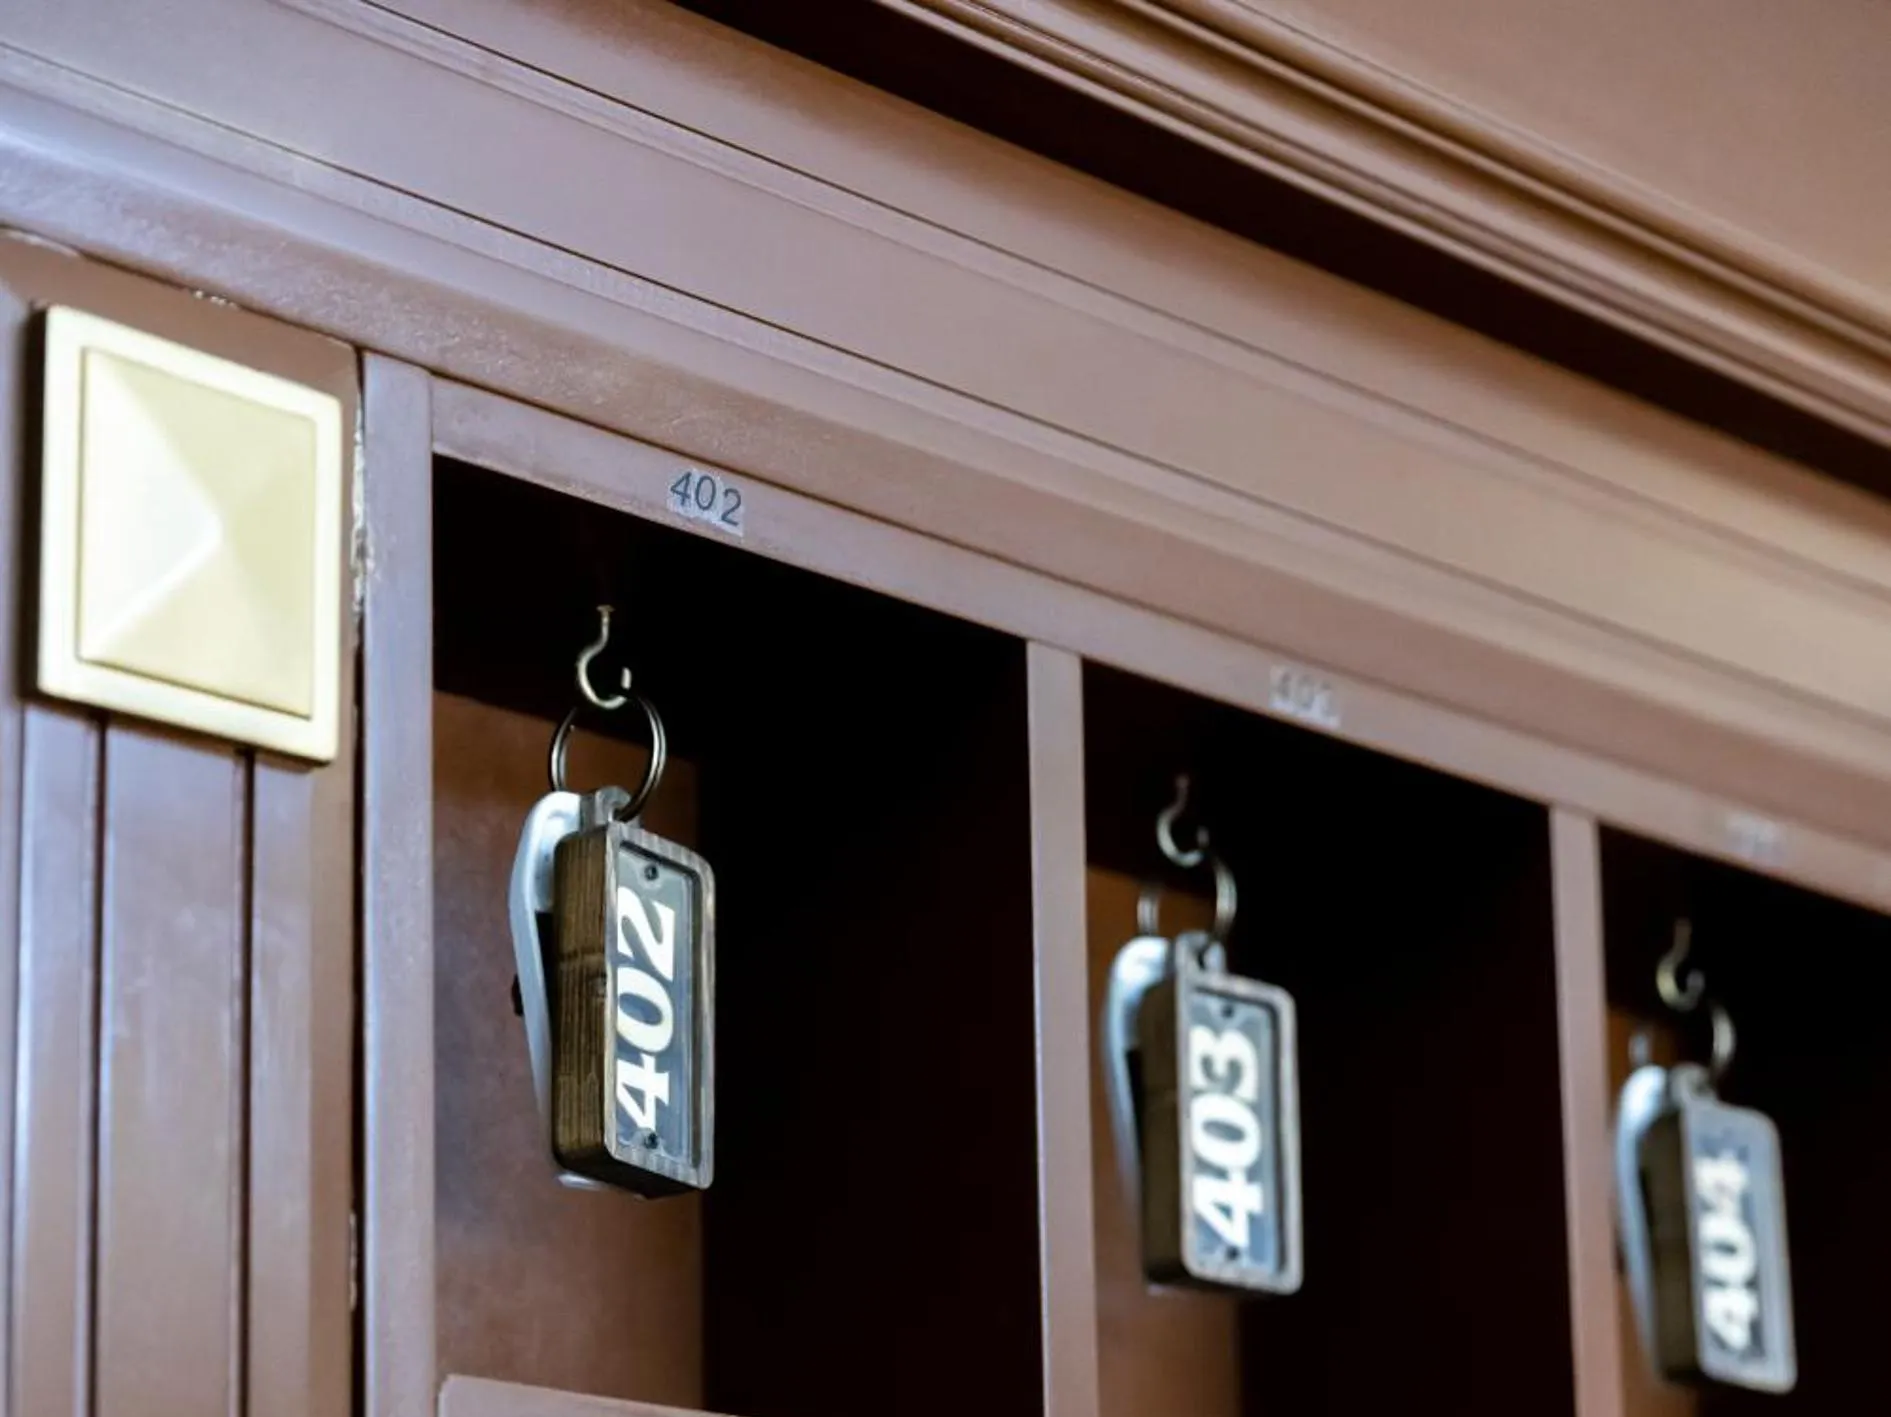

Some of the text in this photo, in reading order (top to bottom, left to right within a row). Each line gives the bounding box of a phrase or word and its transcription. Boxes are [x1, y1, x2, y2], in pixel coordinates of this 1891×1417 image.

[672, 470, 743, 527] 402
[616, 887, 675, 1131] 402
[1189, 1026, 1262, 1247] 403
[1693, 1155, 1758, 1350] 404
